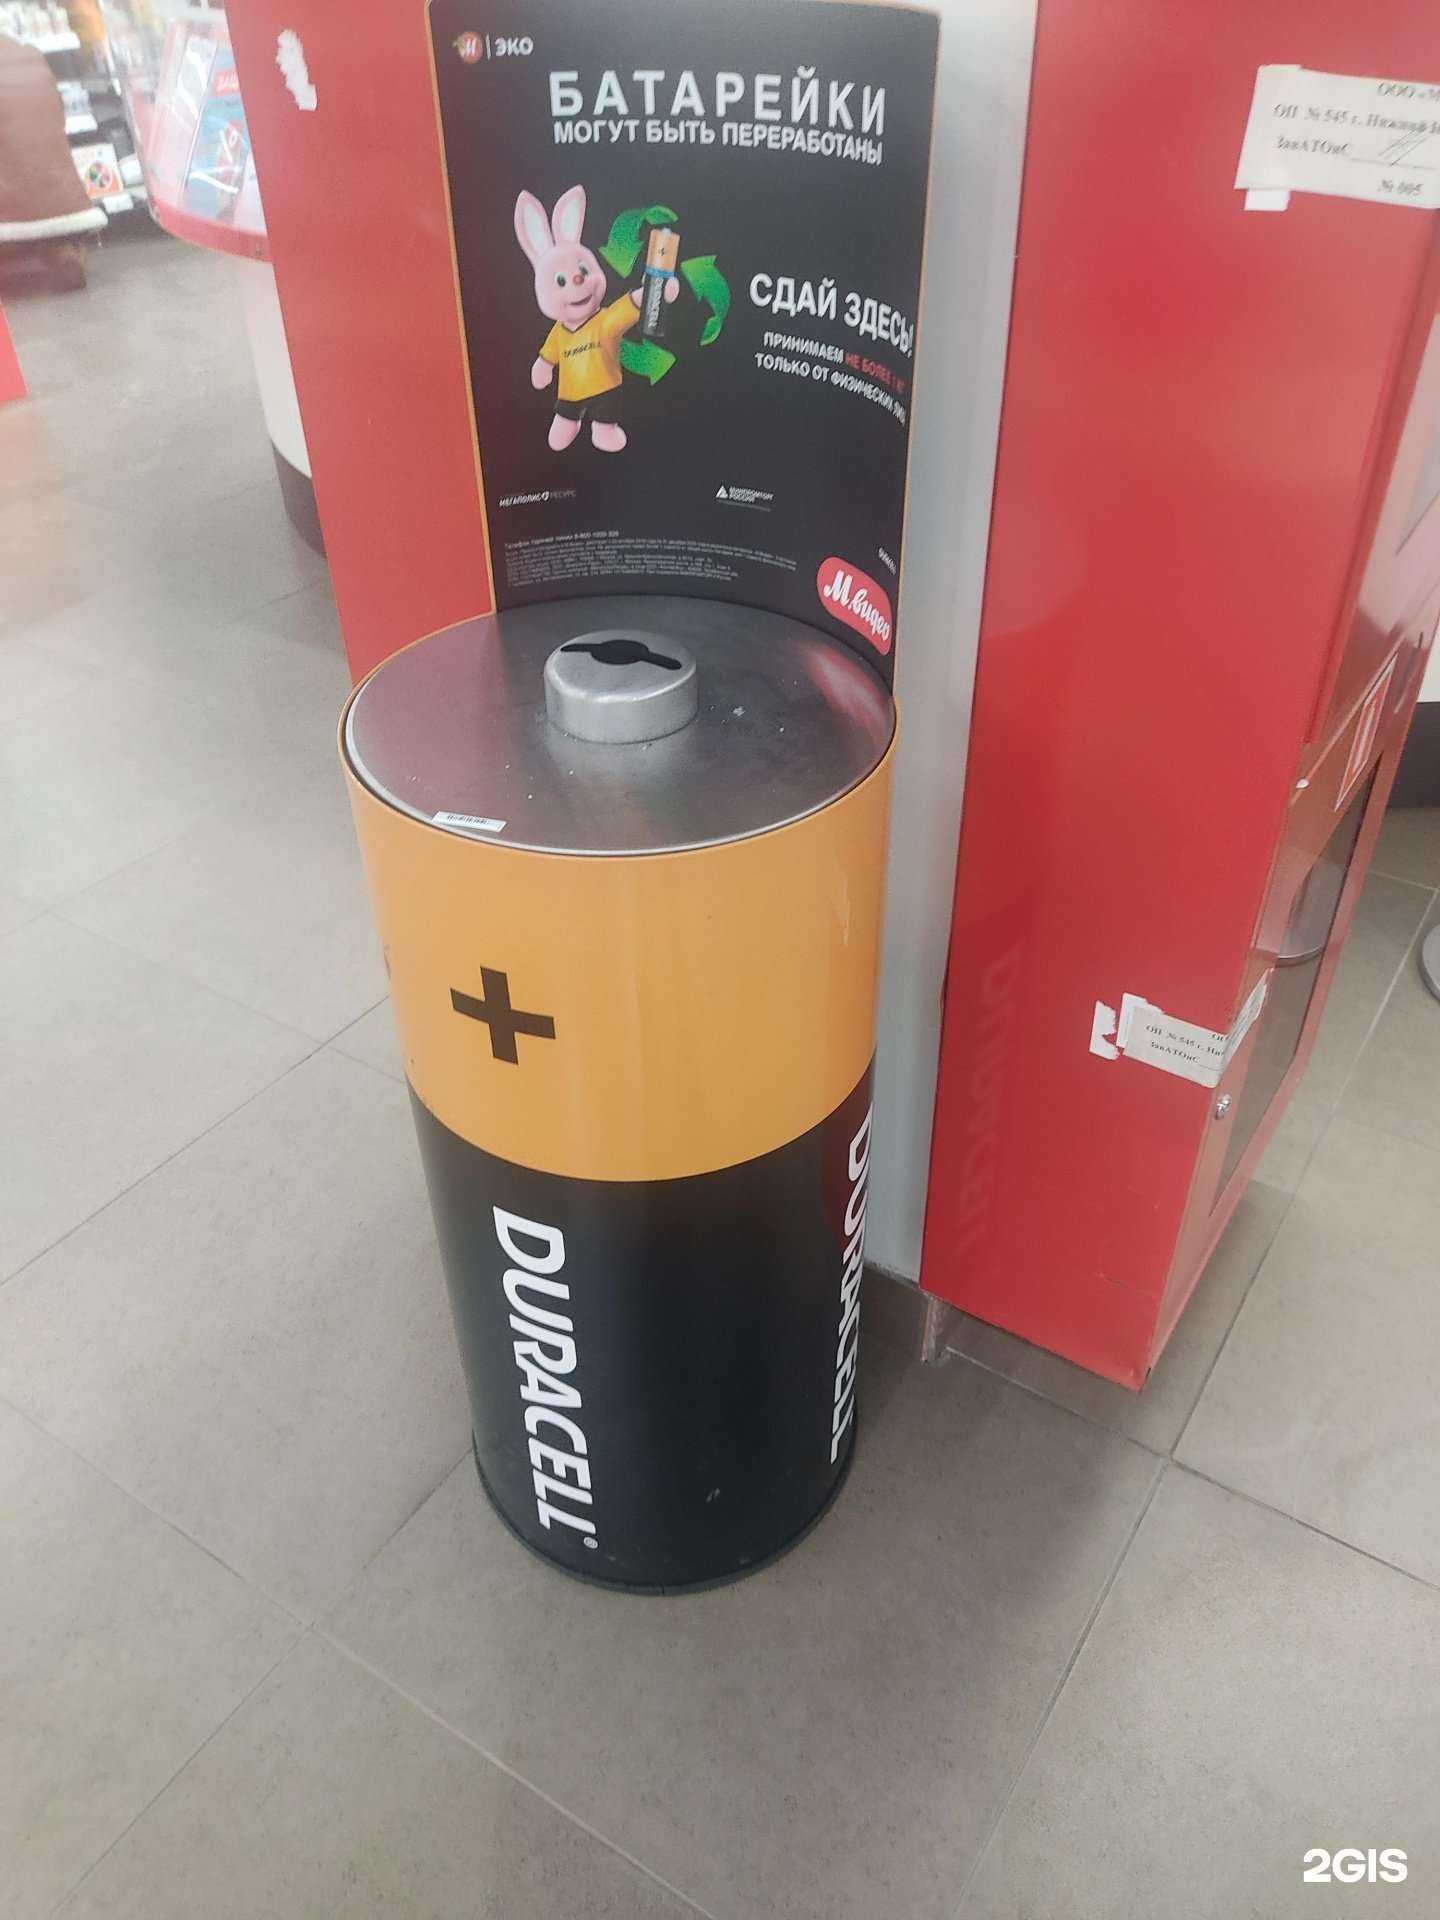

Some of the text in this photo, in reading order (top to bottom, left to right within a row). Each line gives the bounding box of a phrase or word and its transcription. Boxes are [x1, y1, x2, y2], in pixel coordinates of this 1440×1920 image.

[494, 36, 535, 57] ЭКО
[549, 65, 887, 136] БАТАРЕЙКИ
[1324, 109, 1351, 125] 545
[553, 119, 884, 167] МОГУТ БЫТЬ ПЕРЕРАБОТАНЫ
[750, 272, 839, 321] СДАЙ
[763, 331, 845, 365] ПРИНИМАЕМ
[754, 352, 811, 378] ТОЛЬКО
[811, 363, 830, 383] ОТ
